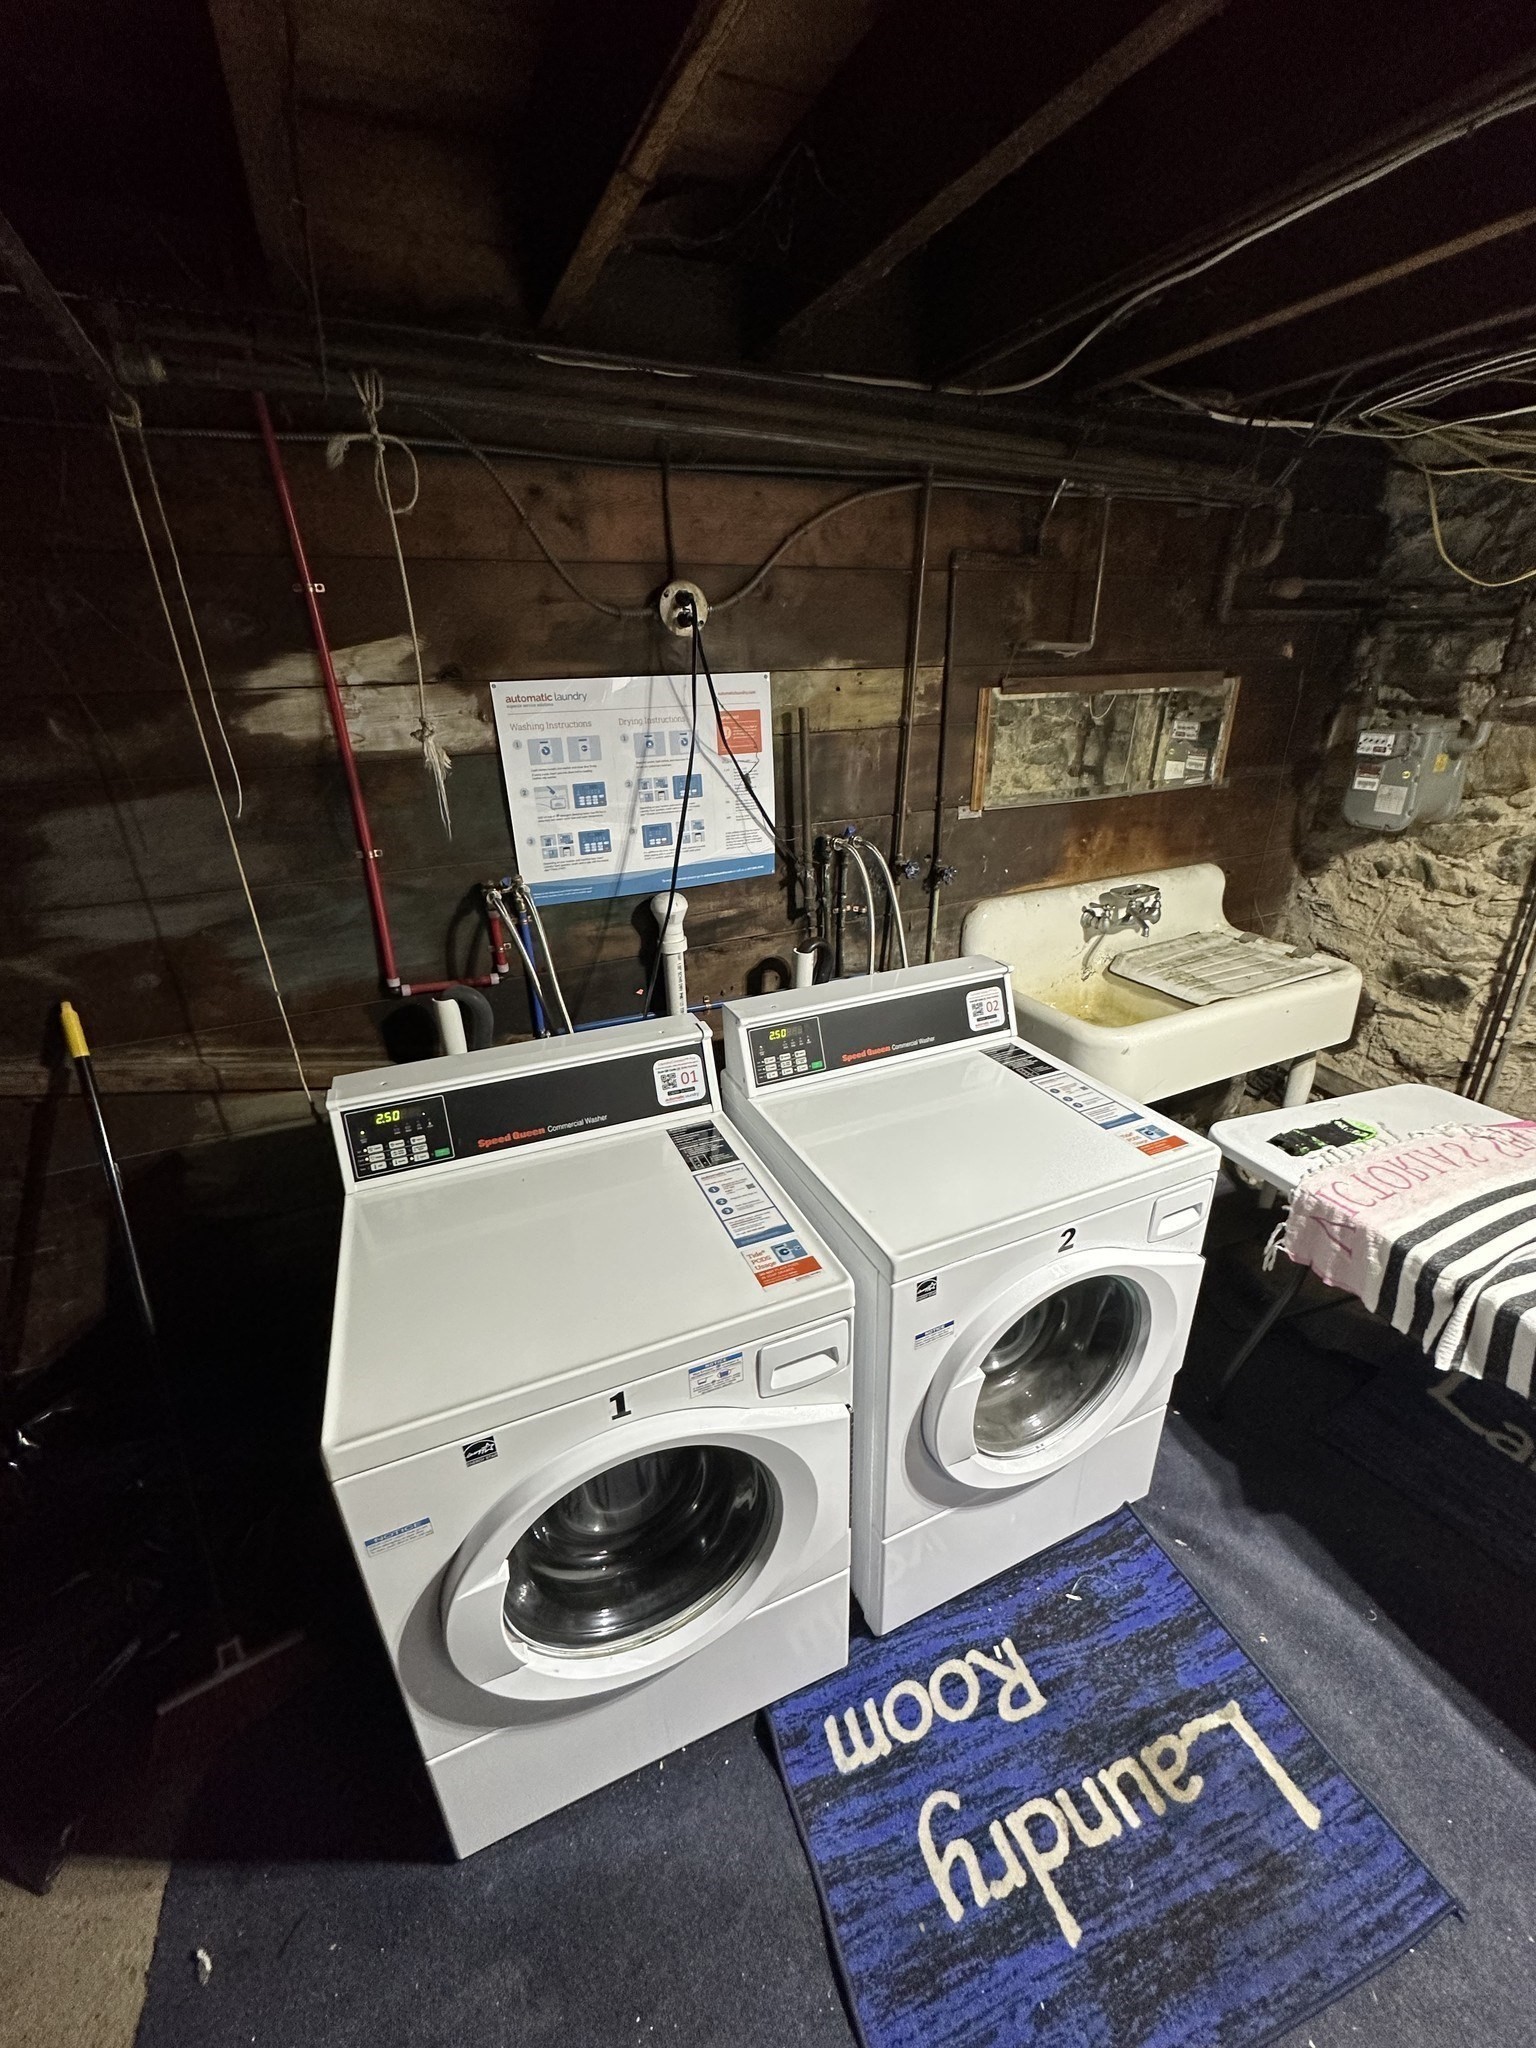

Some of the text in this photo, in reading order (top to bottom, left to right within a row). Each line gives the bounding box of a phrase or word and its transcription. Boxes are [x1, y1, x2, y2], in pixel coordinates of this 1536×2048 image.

[505, 691, 588, 704] automatic laundry
[510, 720, 592, 732] Washing Instructions
[618, 715, 686, 727] Drying Instructions
[986, 1000, 999, 1012] 02
[769, 1028, 787, 1041] 2.50
[842, 1036, 935, 1062] Speed Queen Commercial Washer
[680, 1070, 698, 1085] 01
[376, 1110, 400, 1125] 2.50
[477, 1114, 607, 1148] Speed Queen Commercial Washer
[1058, 1228, 1076, 1253] 2
[755, 1262, 776, 1270] Usage
[610, 1391, 631, 1420] 1
[374, 1523, 418, 1543] NOTICE
[824, 1637, 1047, 1774] Room
[918, 1700, 1322, 1949] Laundry
